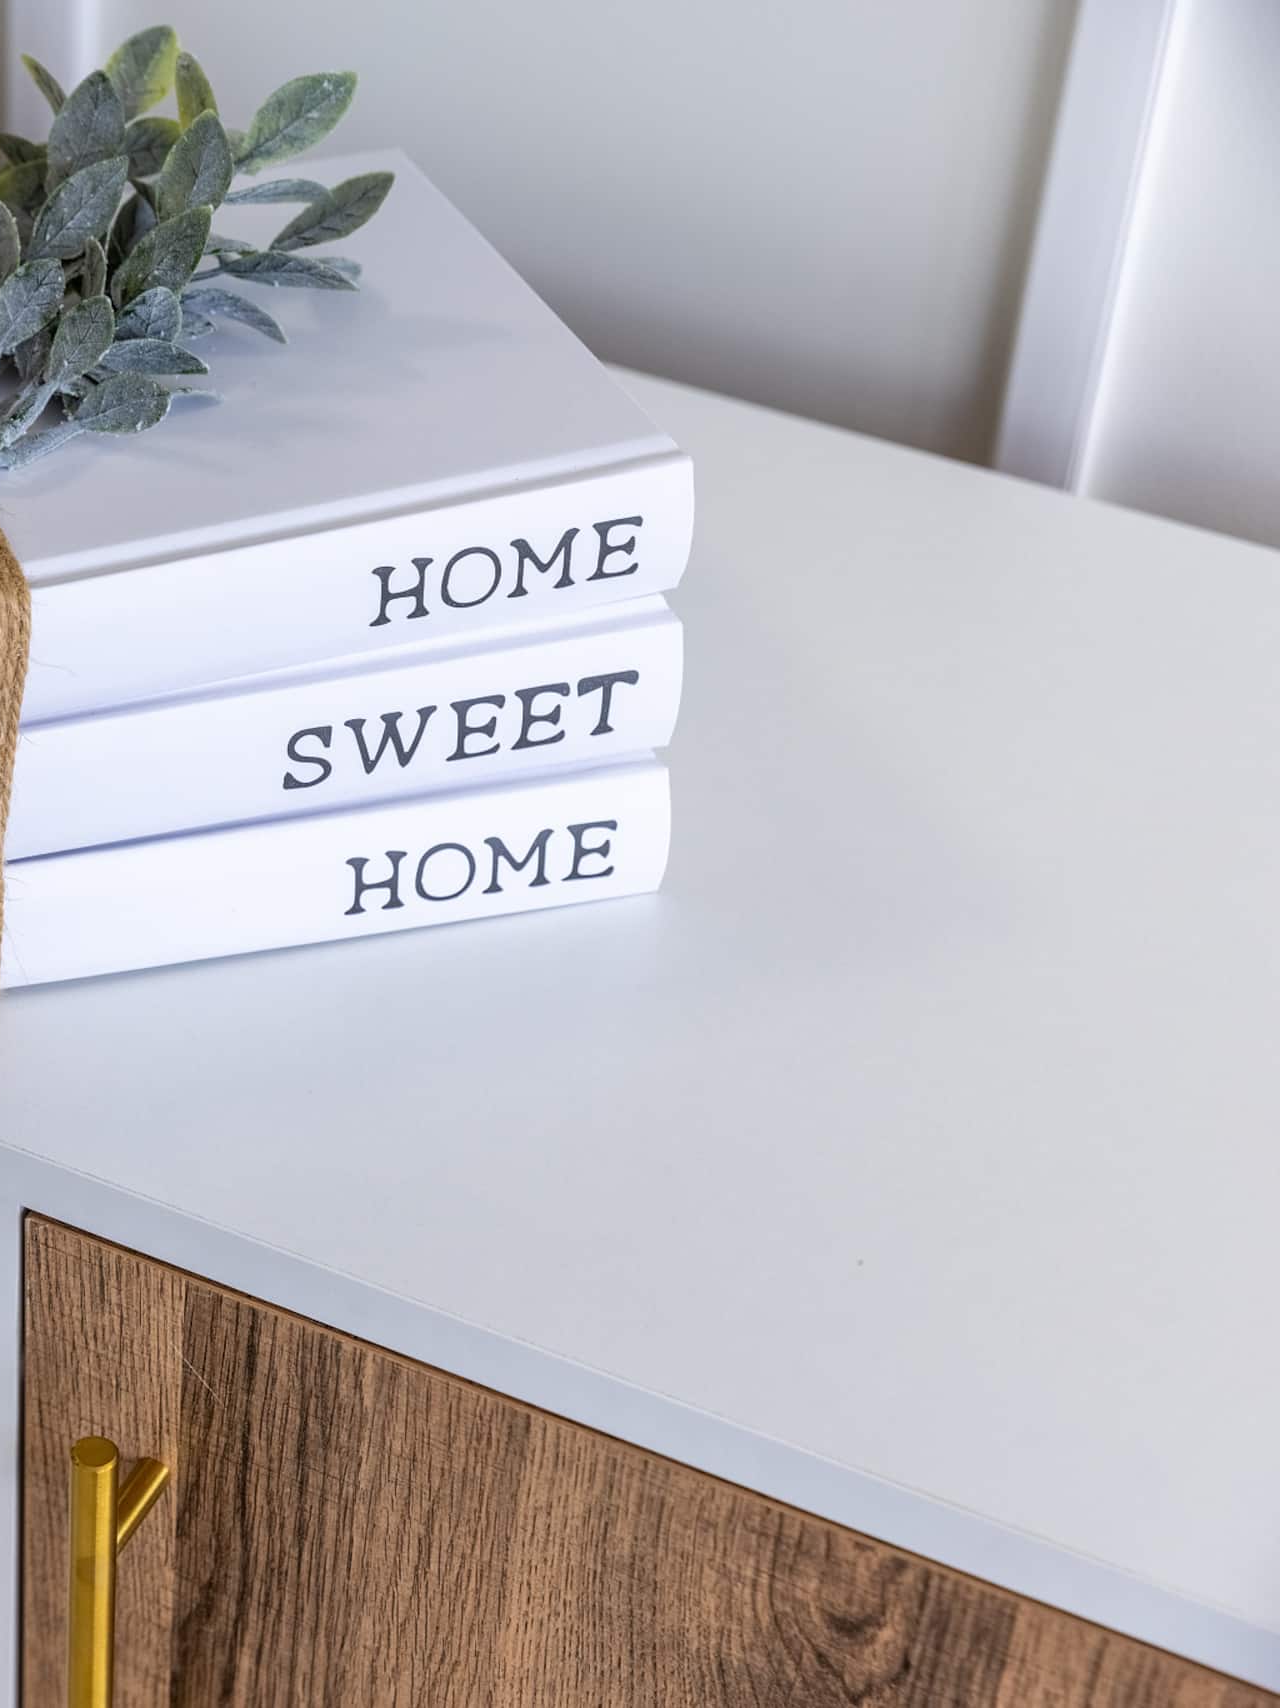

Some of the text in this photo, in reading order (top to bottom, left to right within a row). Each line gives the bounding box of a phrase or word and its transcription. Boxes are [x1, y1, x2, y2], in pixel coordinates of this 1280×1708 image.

[369, 515, 644, 627] HOME
[282, 670, 639, 790] SWEET
[344, 820, 618, 916] HOME
